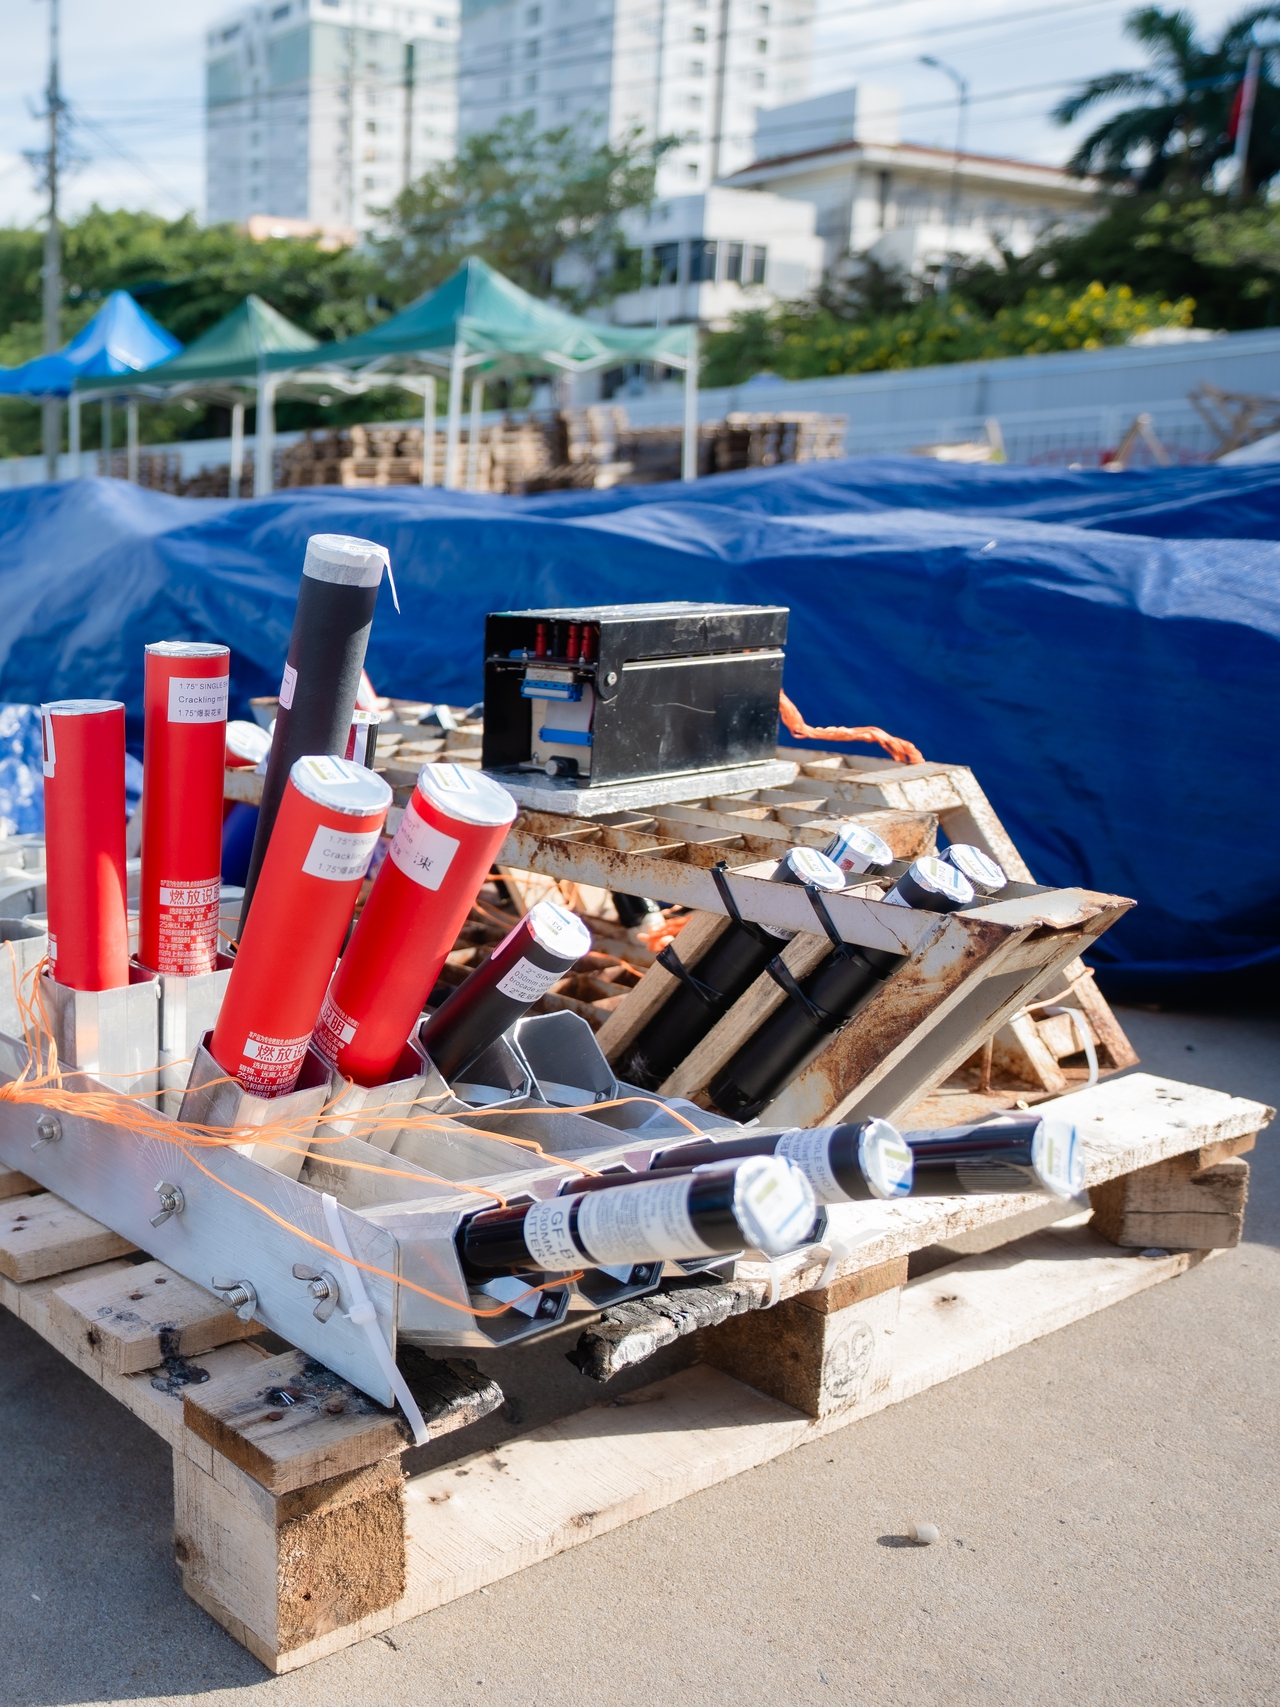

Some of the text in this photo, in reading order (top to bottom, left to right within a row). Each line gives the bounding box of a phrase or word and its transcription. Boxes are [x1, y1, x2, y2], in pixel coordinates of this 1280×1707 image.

[200, 681, 222, 690] SINGLE
[178, 695, 216, 705] Crackling
[329, 835, 351, 846] 1.75"
[520, 963, 536, 975] 1.2"
[509, 976, 536, 993] brocade
[514, 970, 539, 986] 030mm
[803, 1163, 816, 1185] head
[816, 1165, 836, 1192] SHOT
[540, 1207, 556, 1256] 030MM
